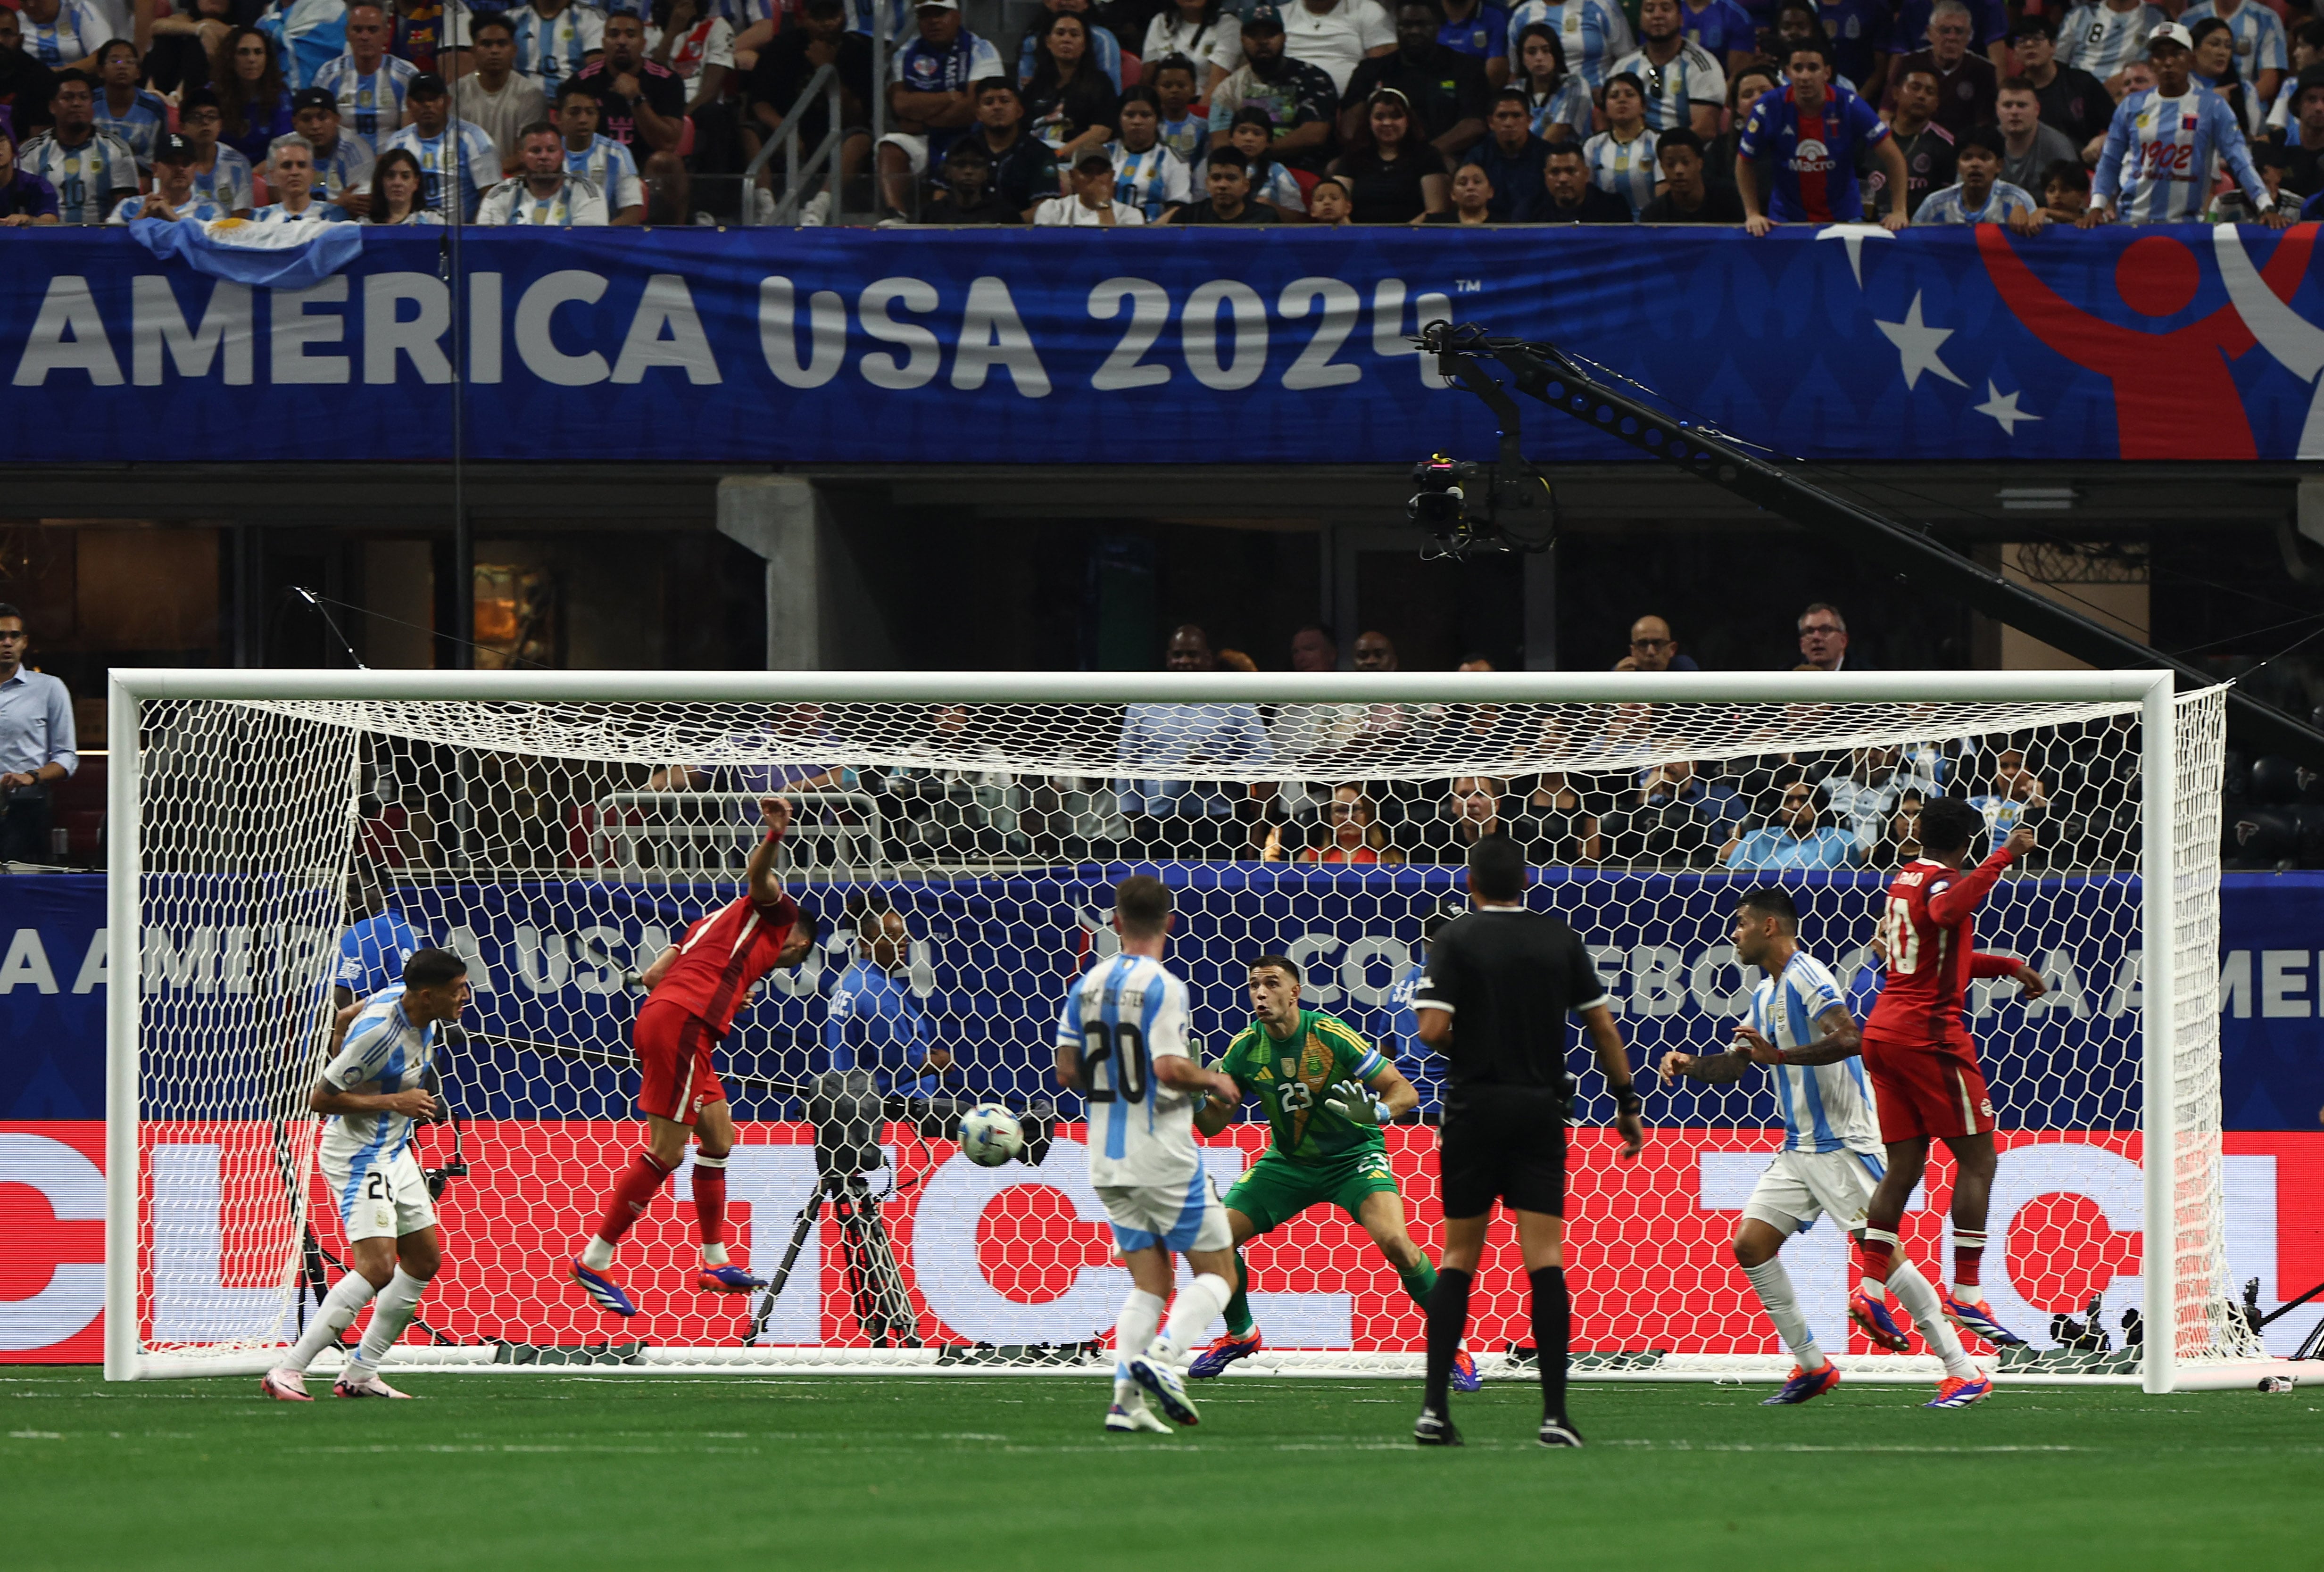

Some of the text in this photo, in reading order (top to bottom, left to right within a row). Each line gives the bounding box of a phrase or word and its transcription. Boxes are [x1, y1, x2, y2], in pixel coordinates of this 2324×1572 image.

[1788, 158, 1836, 172] Macro
[2141, 141, 2192, 169] 1902
[12, 269, 723, 387] AMERICA
[758, 275, 1052, 398] USA
[1087, 277, 1456, 391] 2024
[1084, 1019, 1146, 1104] 20
[1278, 1083, 1313, 1113] 23
[1356, 1153, 1389, 1173] 23
[673, 1135, 1353, 1349] TCL
